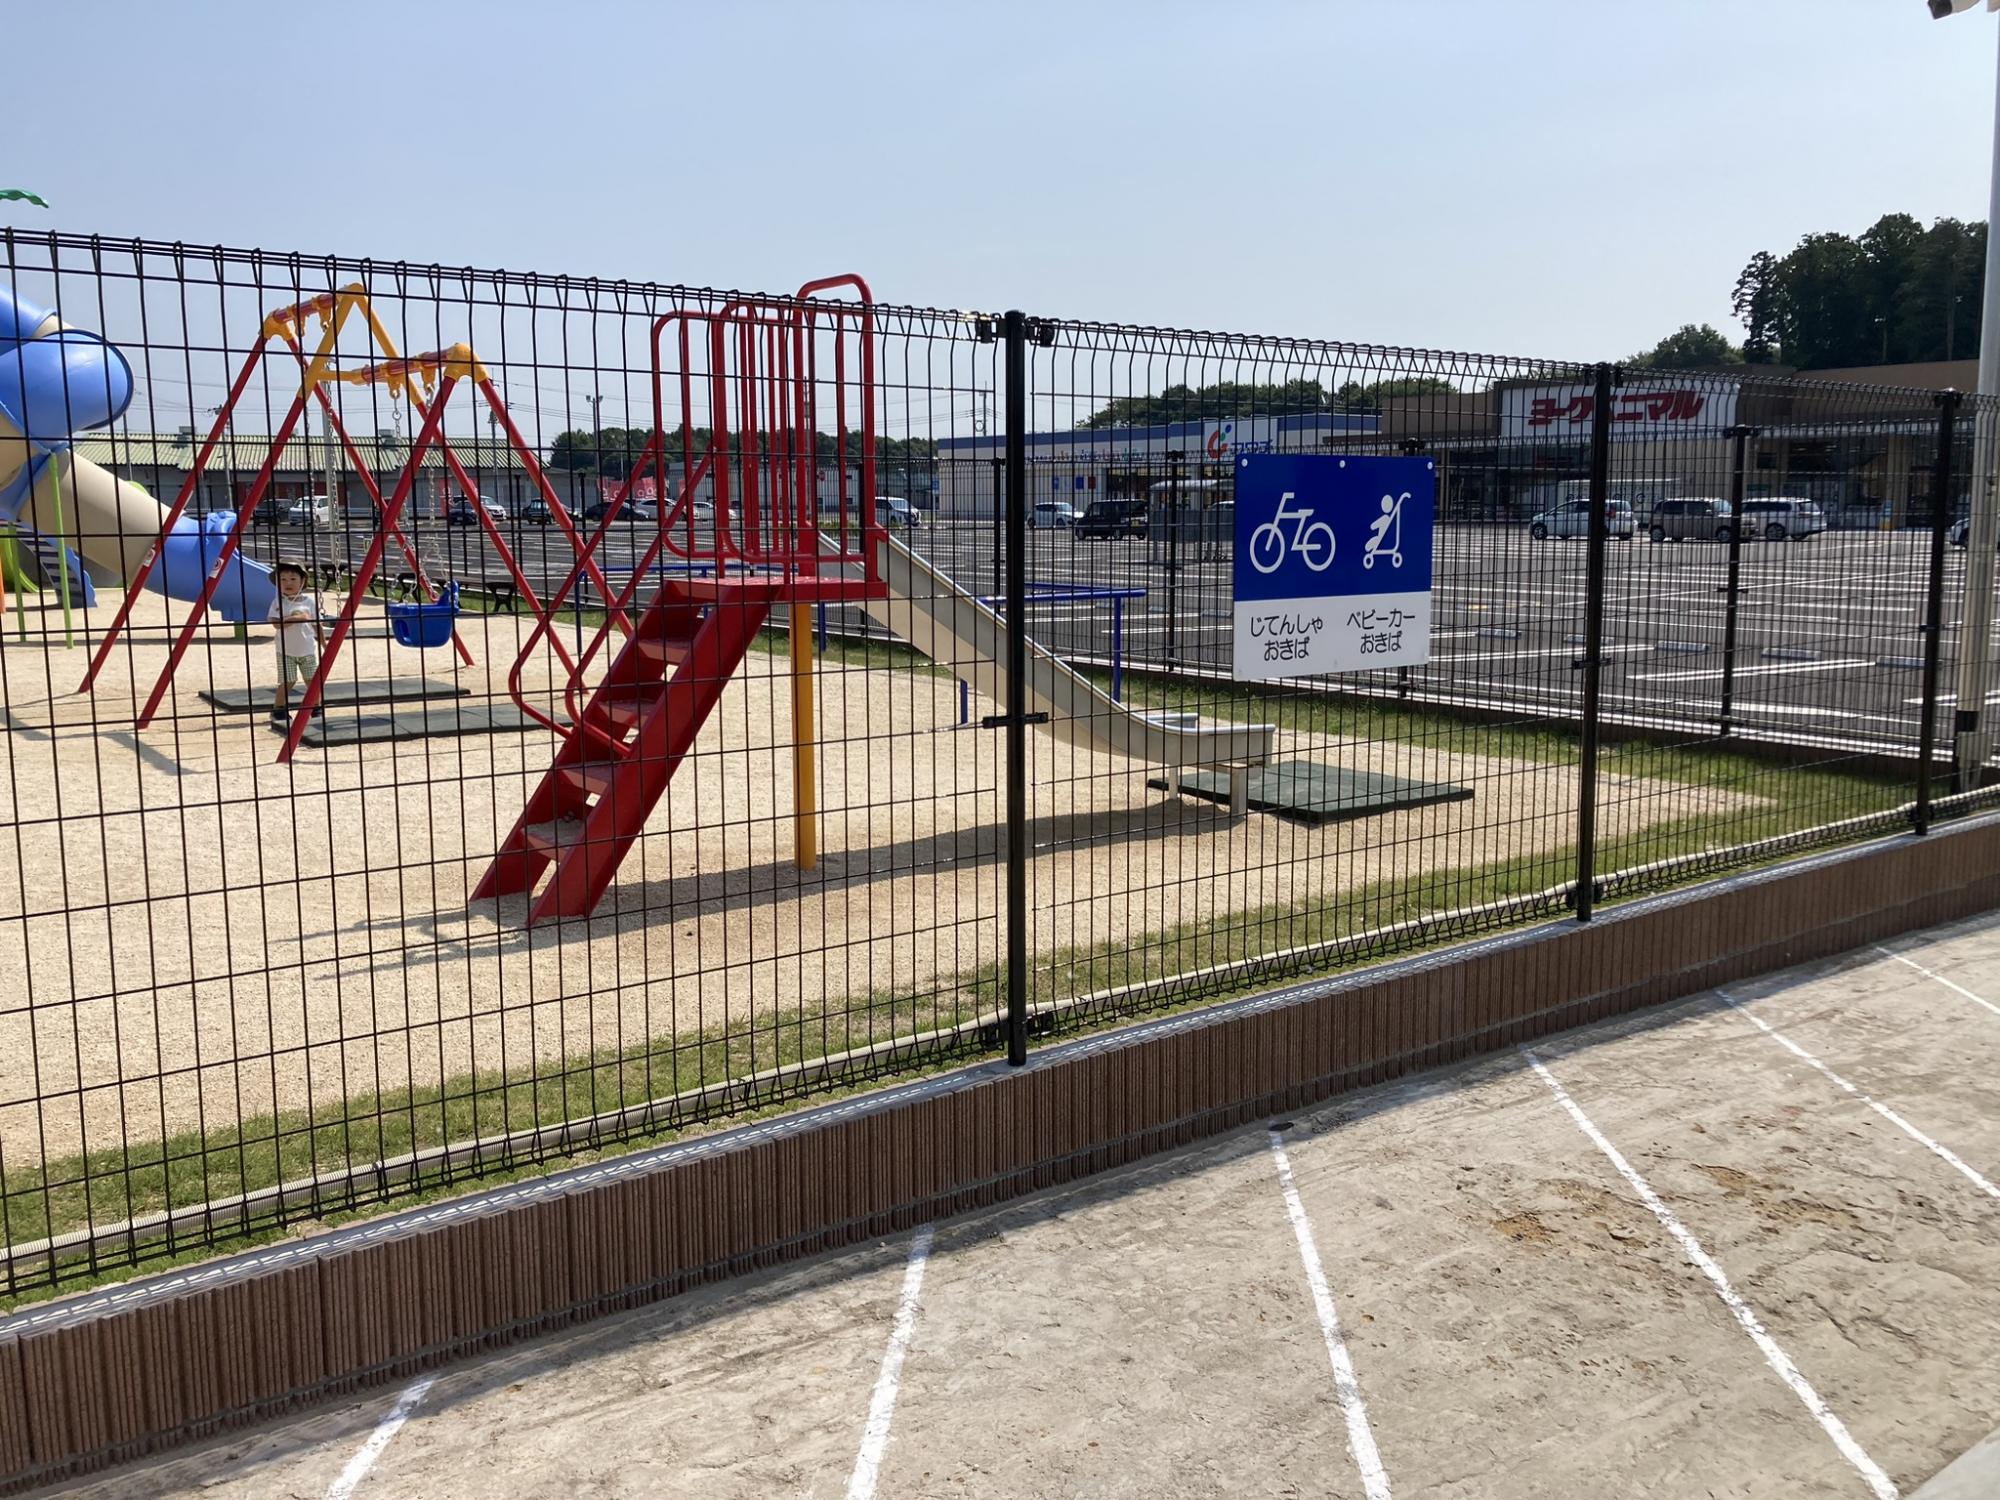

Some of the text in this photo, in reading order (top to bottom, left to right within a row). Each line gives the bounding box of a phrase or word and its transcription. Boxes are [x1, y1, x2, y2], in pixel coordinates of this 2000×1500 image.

[1528, 391, 1704, 425] ヨークニマル
[1250, 613, 1323, 637] じてんしゃ
[1264, 636, 1310, 661] おきば
[1360, 630, 1402, 654] おきば
